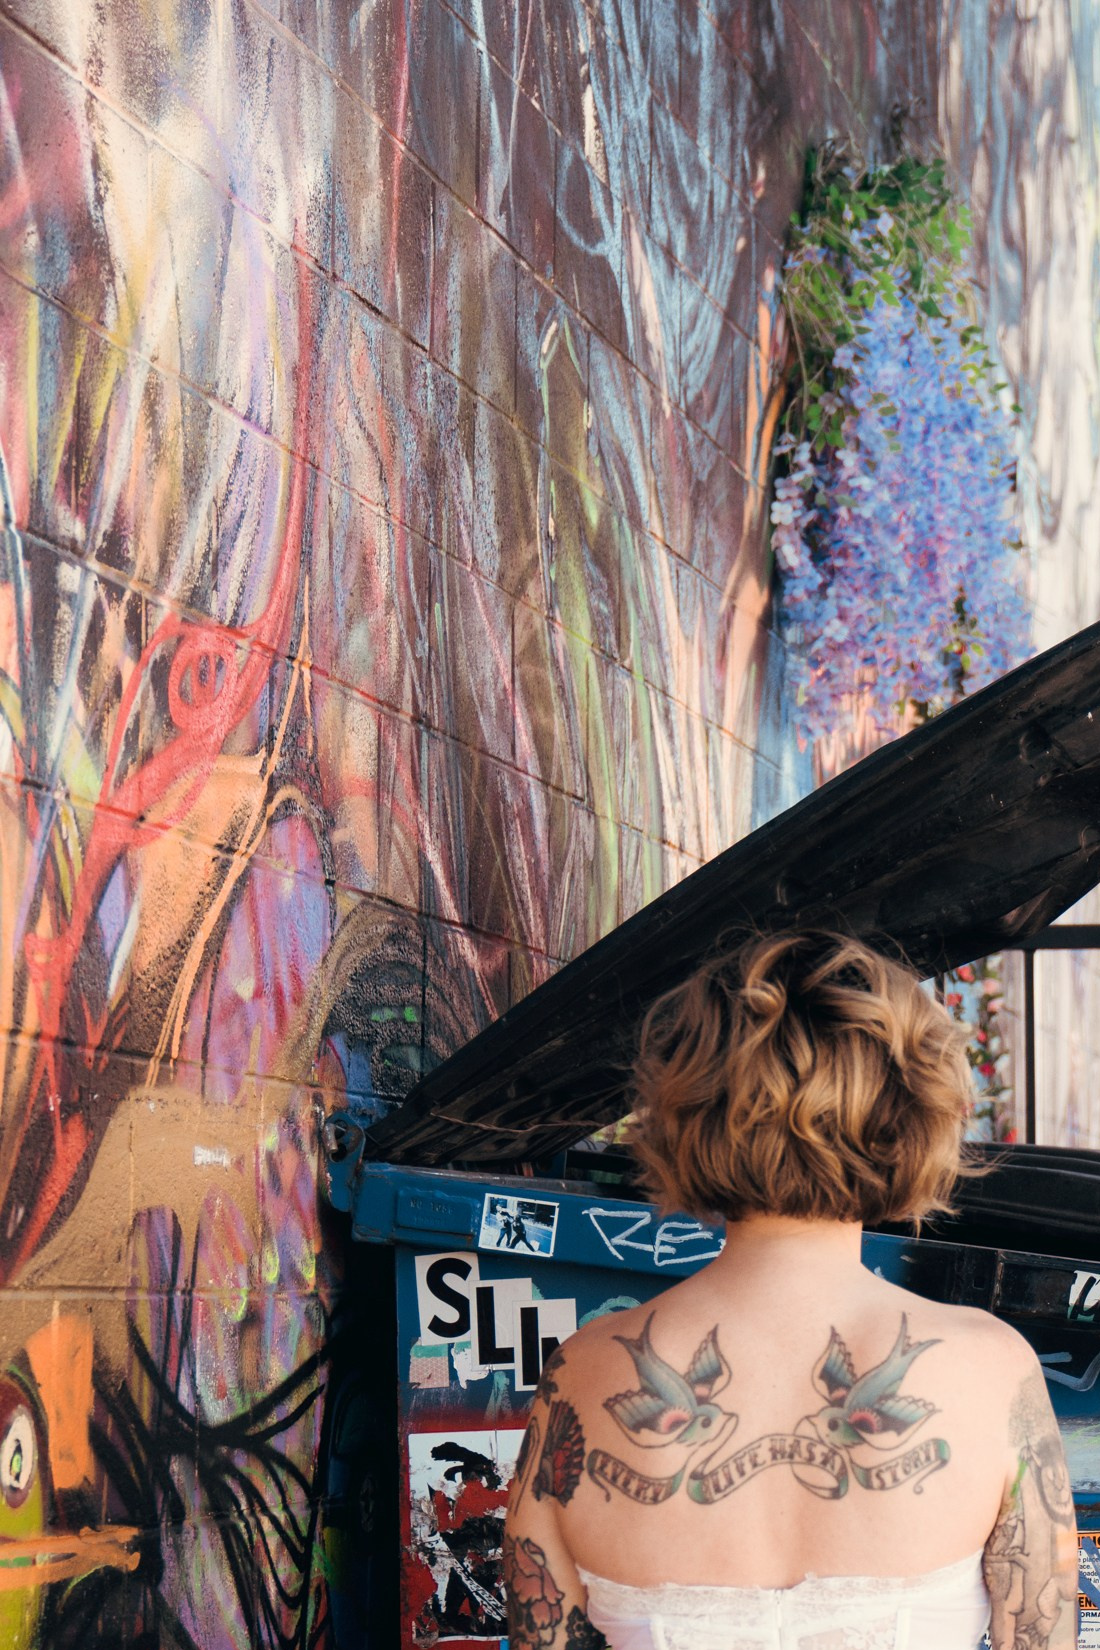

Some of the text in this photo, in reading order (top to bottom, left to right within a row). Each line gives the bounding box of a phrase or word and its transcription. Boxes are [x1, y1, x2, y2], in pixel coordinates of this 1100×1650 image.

[425, 1257, 562, 1386] SLI
[598, 1452, 668, 1501] EVERY
[711, 1444, 767, 1494] LIFE
[873, 1439, 943, 1490] STORY
